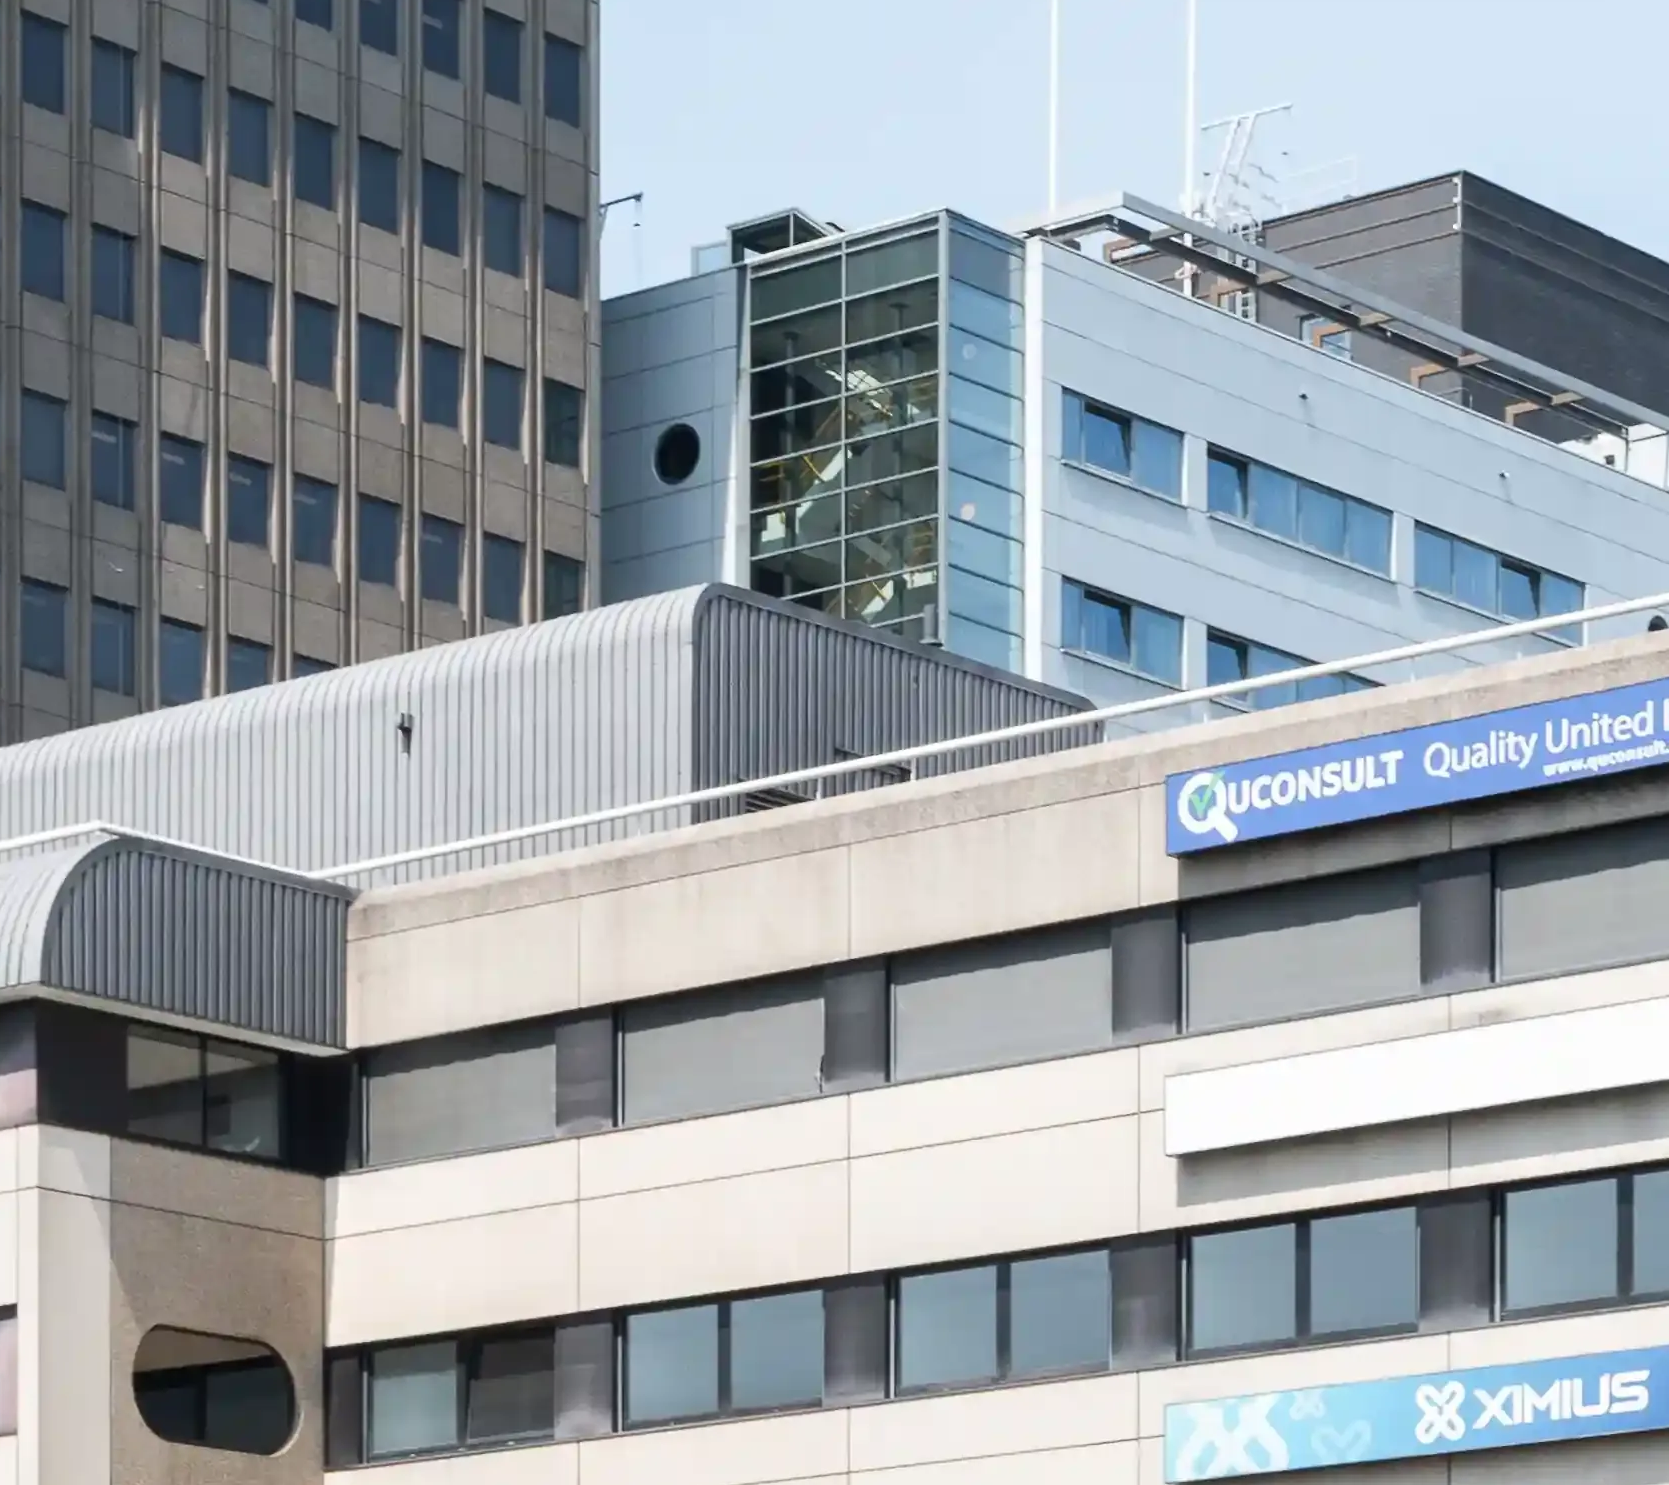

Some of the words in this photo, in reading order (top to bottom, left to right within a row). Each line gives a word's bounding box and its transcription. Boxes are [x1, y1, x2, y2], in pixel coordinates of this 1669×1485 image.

[1177, 750, 1404, 842] QUCONSULT
[1422, 730, 1538, 779] Quality
[1544, 699, 1655, 755] United
[1472, 1369, 1651, 1429] XIMIUS
